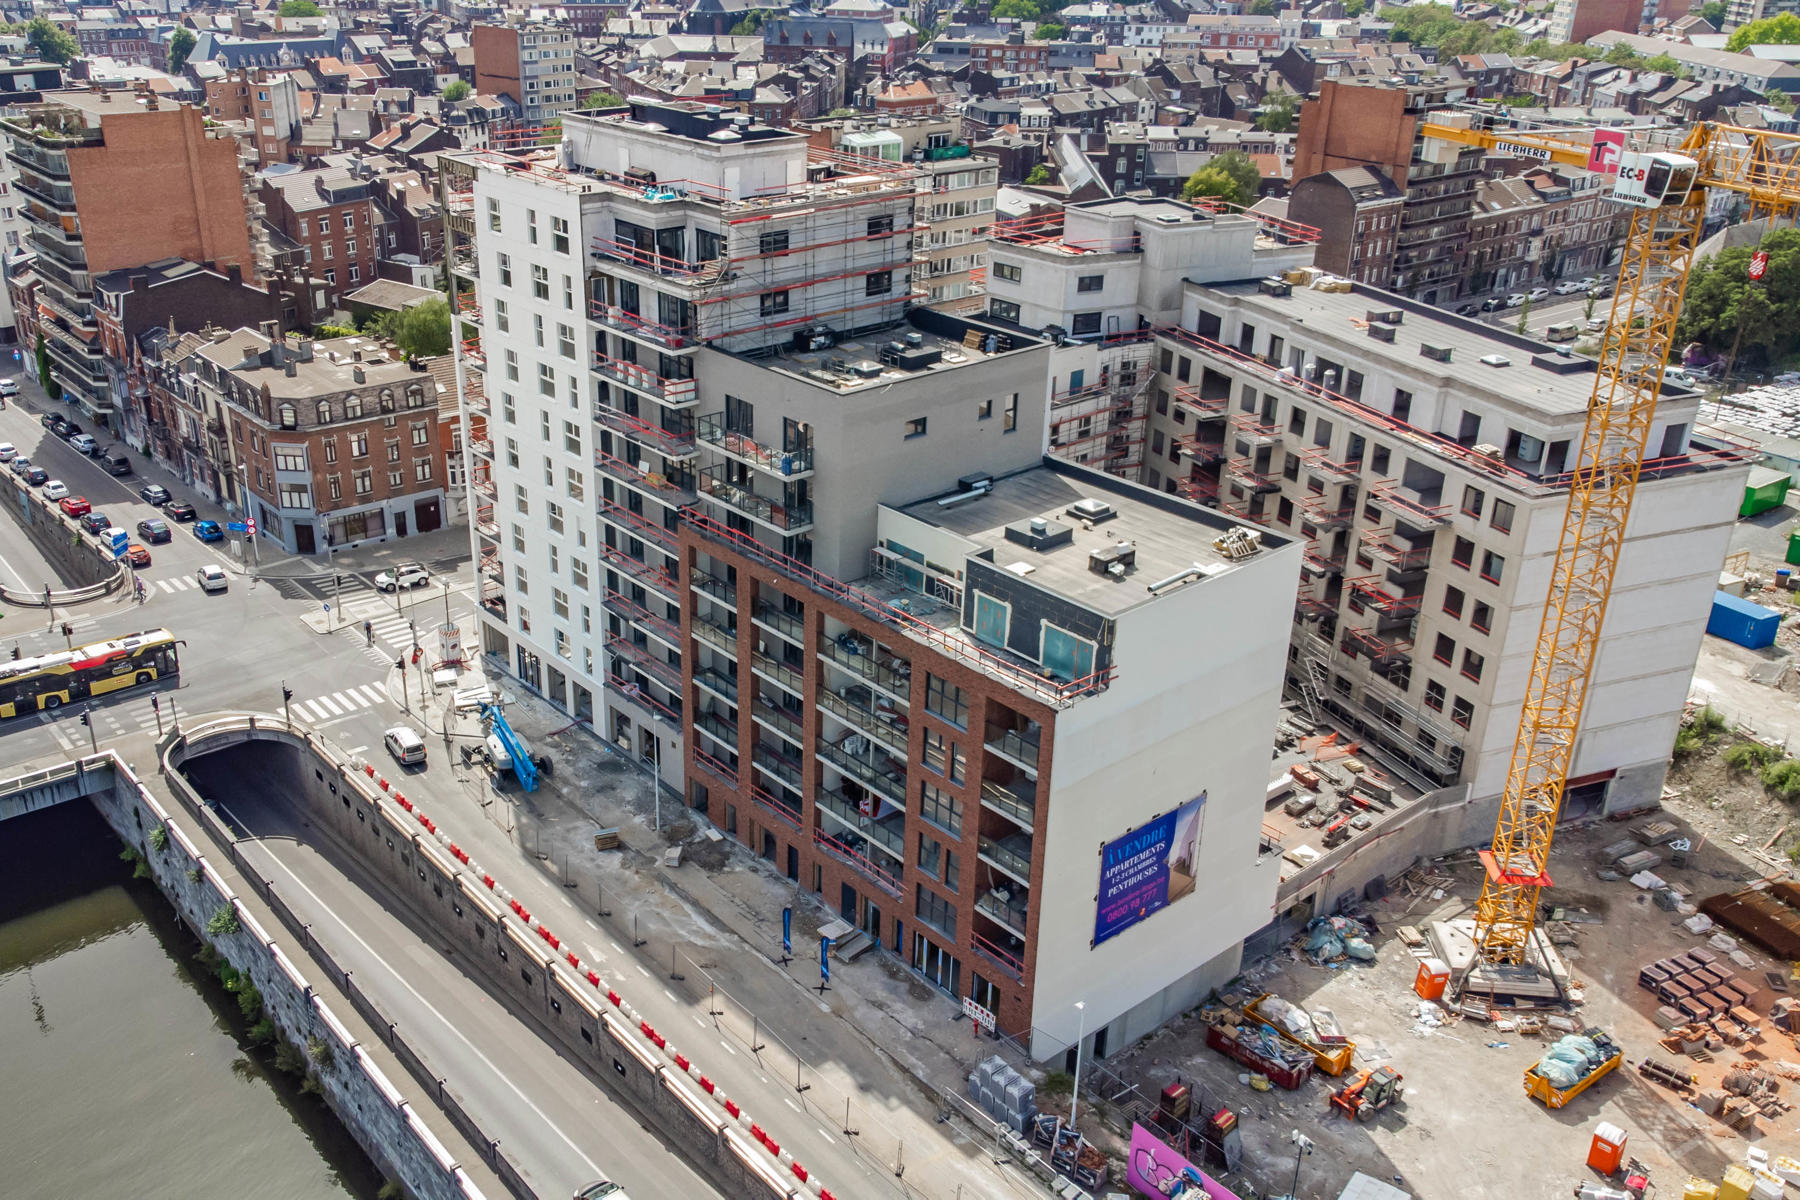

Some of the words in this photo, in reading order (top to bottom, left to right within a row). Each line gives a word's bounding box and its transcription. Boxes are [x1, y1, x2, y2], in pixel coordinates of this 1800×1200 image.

[1498, 142, 1547, 159] LIEBHERR
[1619, 166, 1645, 181] EC-B
[1104, 840, 1166, 880] APPARTEMENTS
[1116, 825, 1167, 861] VENDRE
[1107, 863, 1159, 898] PENTHOUSES
